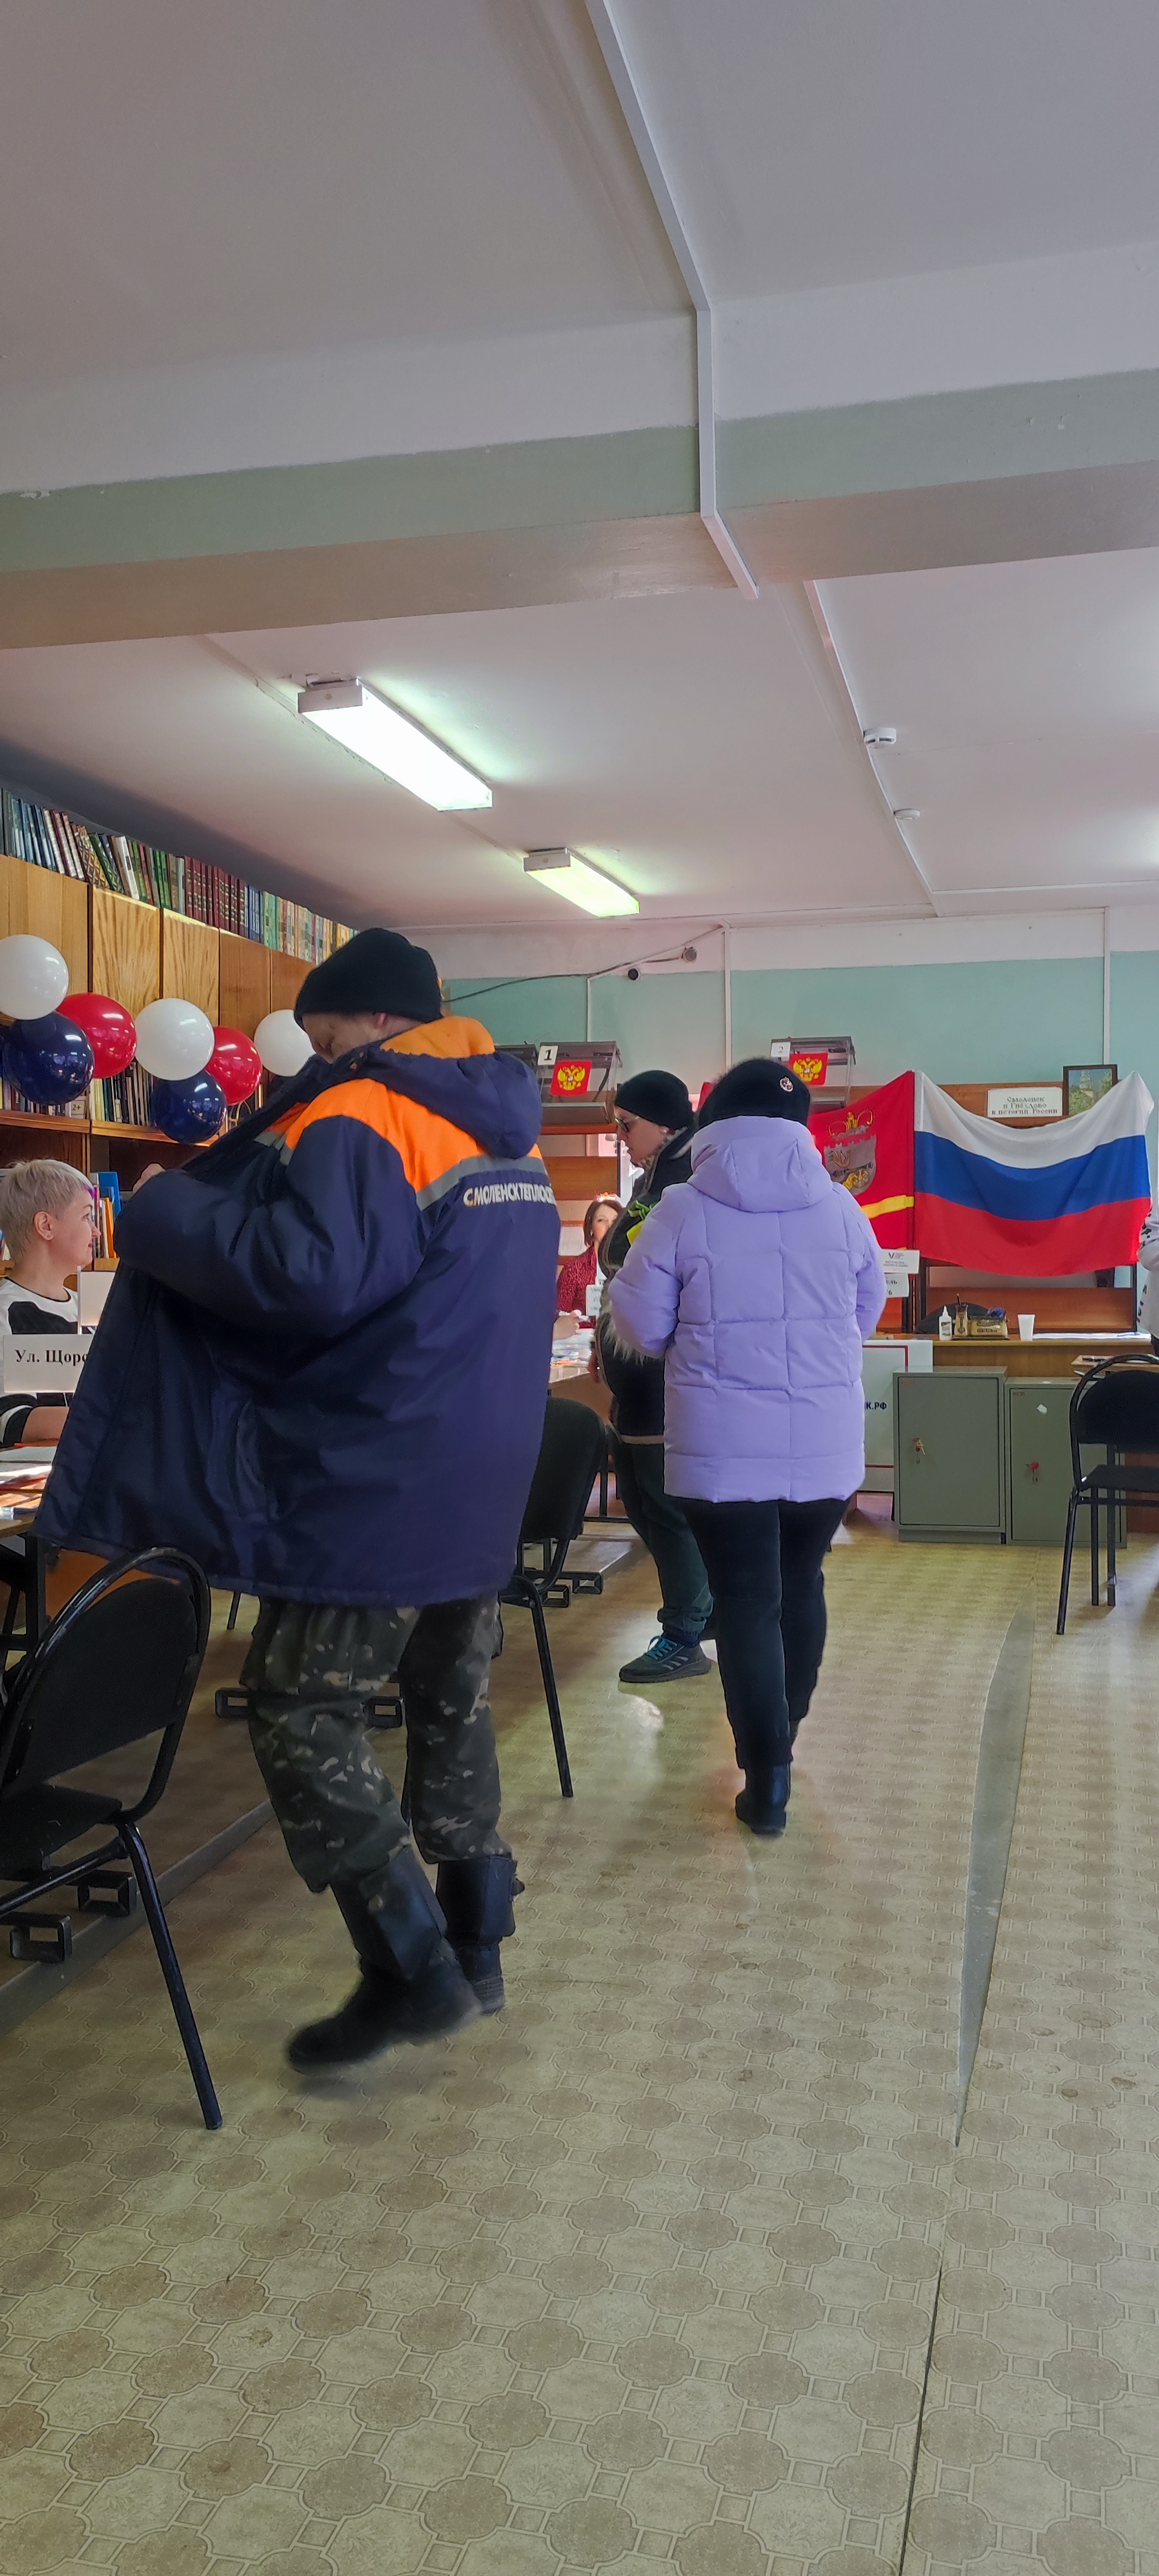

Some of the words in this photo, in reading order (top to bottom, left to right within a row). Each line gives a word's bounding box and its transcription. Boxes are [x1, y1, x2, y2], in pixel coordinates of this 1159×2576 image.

[543, 1049, 552, 1061] 1
[778, 1045, 784, 1054] 2
[463, 1182, 556, 1207] СМОЛЕНСКТЕПЛОС
[14, 1349, 40, 1363] Ул.
